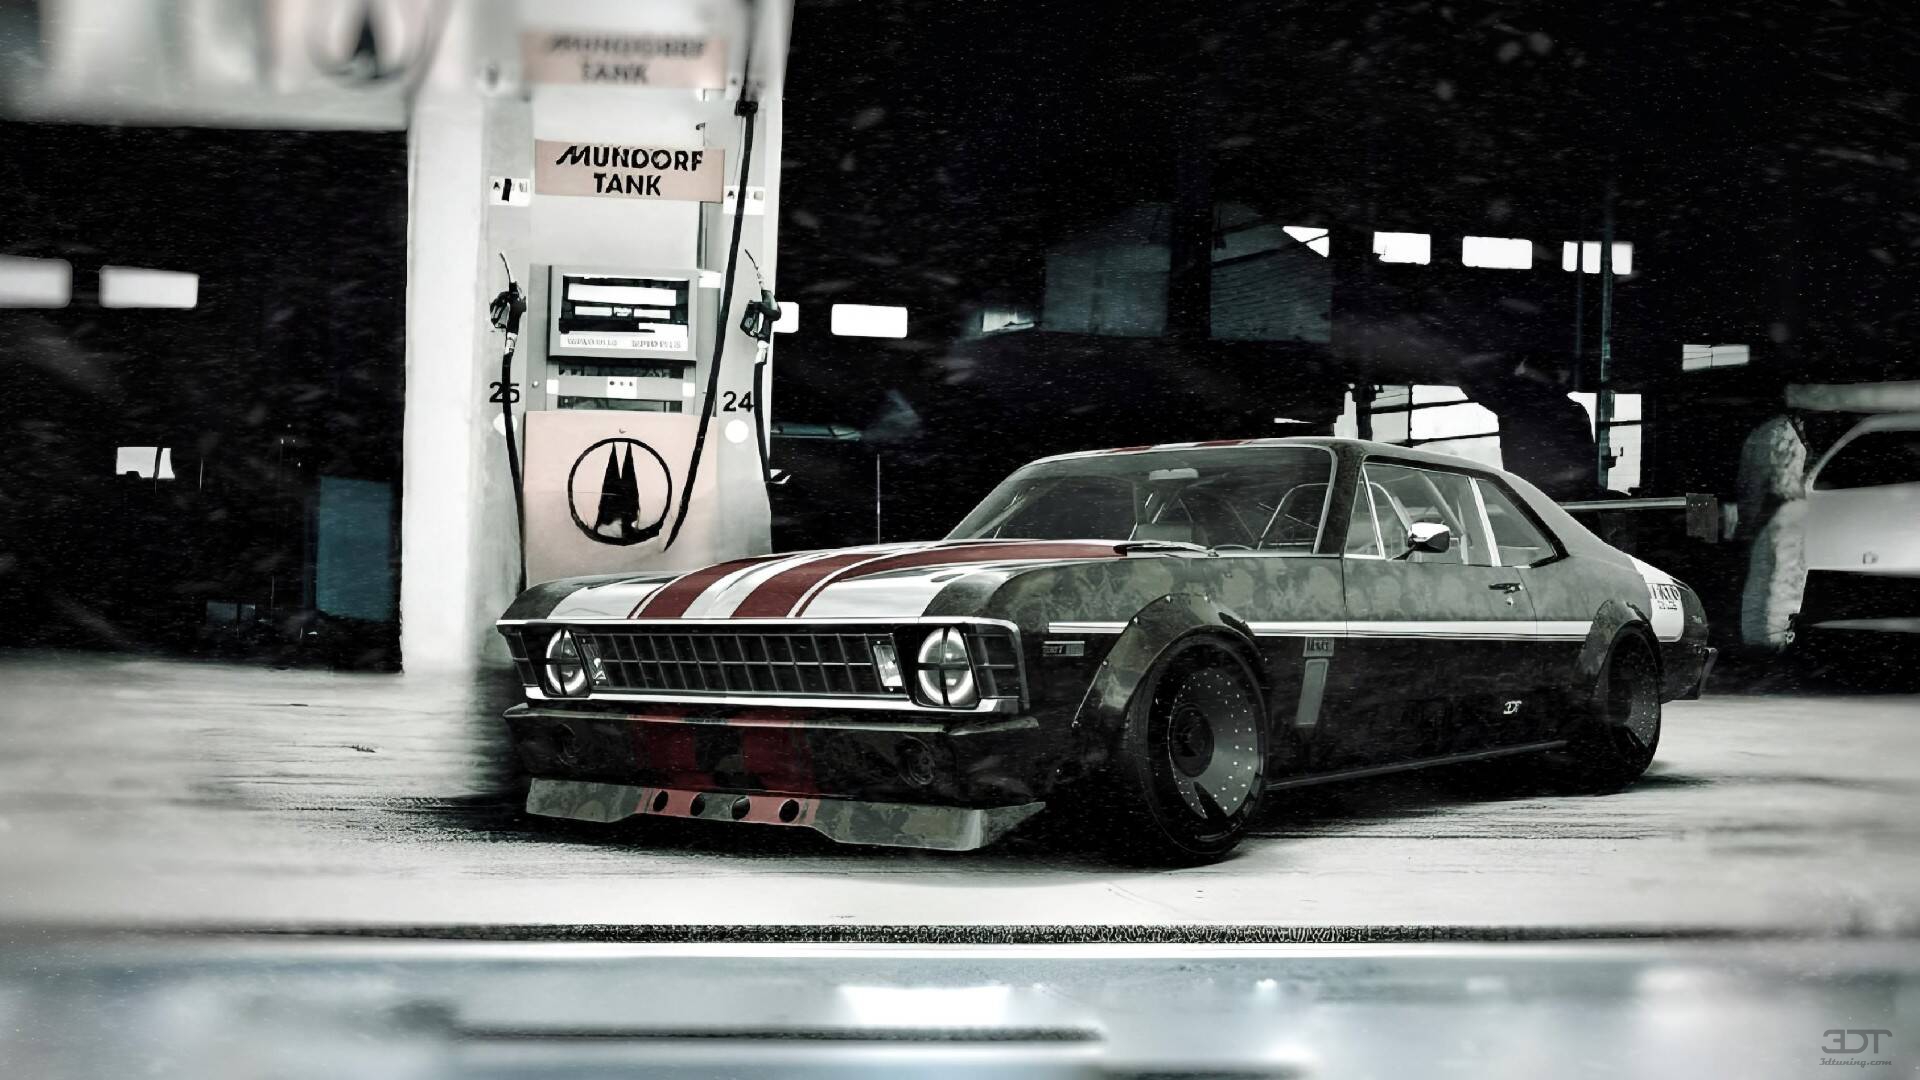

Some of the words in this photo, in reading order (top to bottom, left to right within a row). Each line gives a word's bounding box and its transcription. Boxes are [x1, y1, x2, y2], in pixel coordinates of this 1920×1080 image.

[555, 145, 704, 172] MUNDORF
[593, 172, 662, 196] TANK
[723, 391, 754, 413] 24
